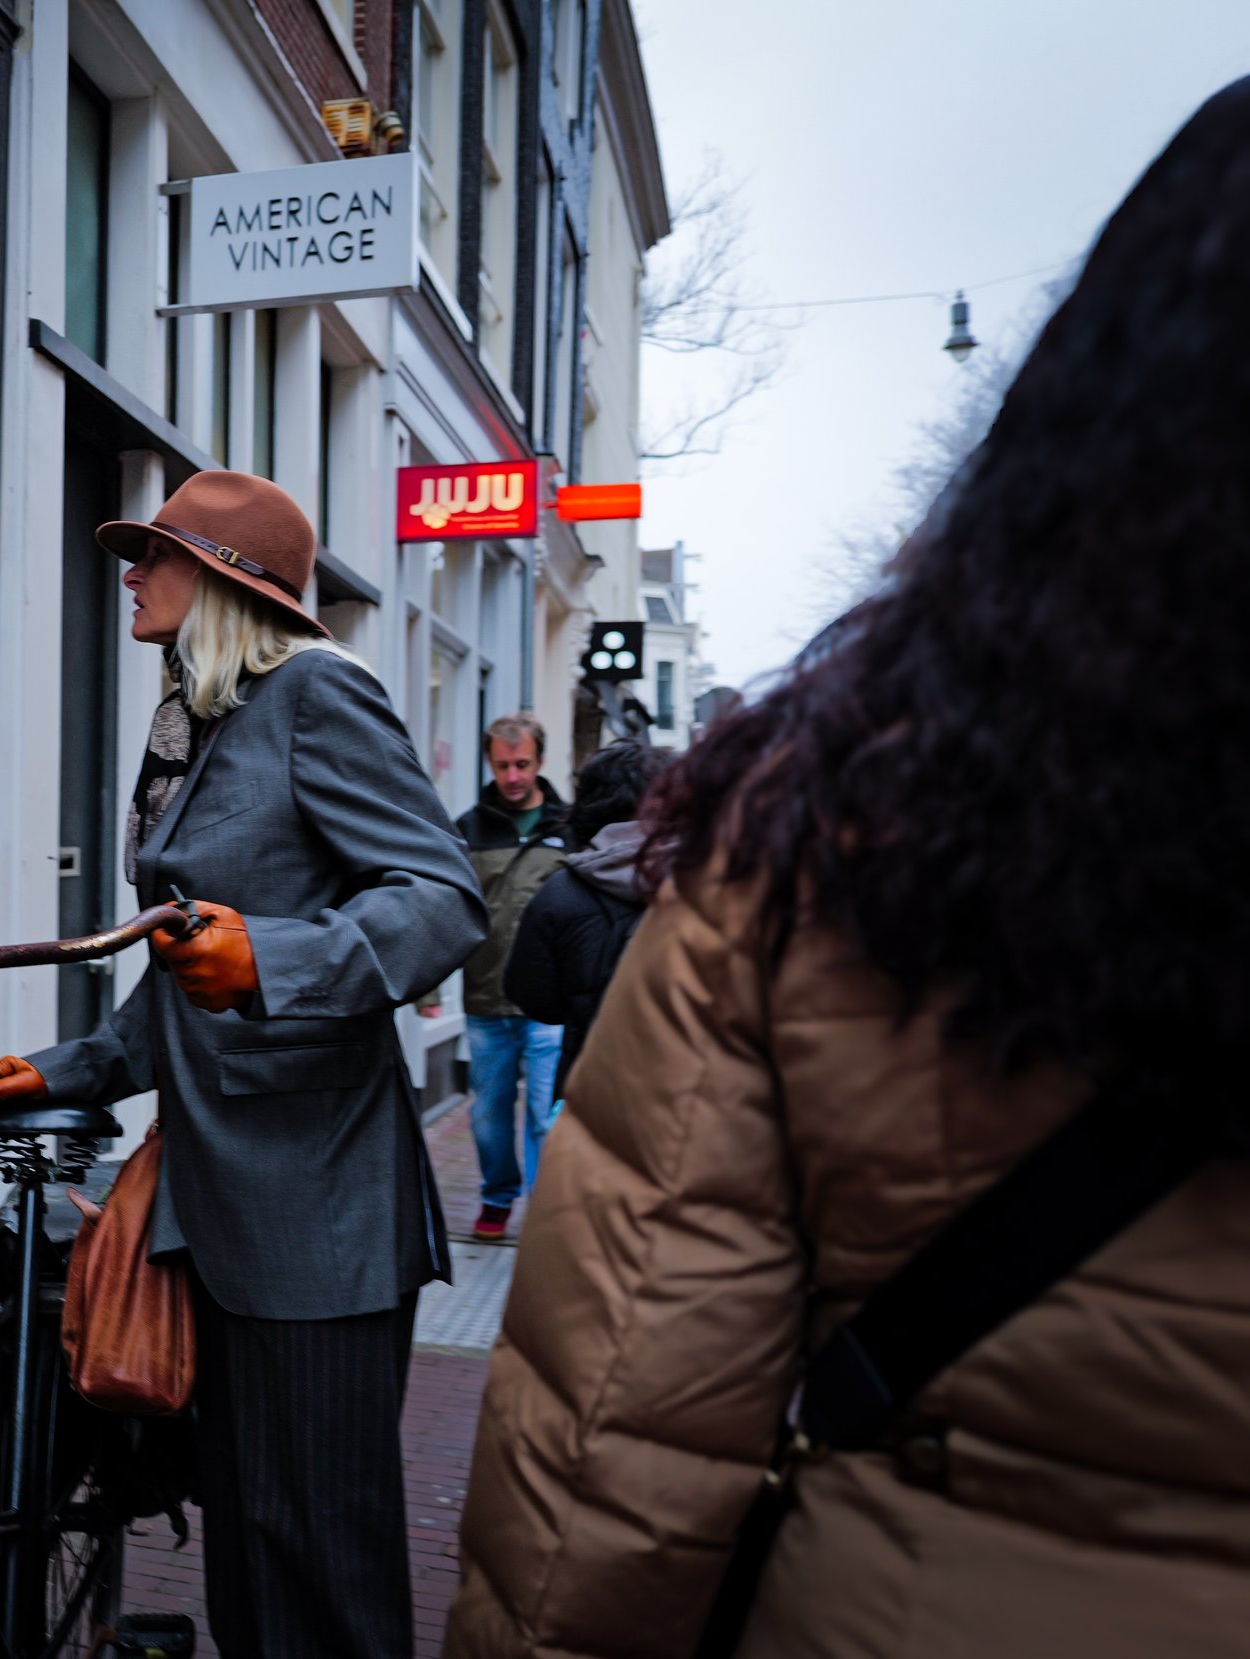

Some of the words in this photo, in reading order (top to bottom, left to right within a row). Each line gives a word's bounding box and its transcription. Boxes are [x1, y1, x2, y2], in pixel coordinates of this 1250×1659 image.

[210, 186, 393, 237] AMERICAN
[228, 228, 375, 272] VINTAGE
[409, 473, 524, 517] JUJU
